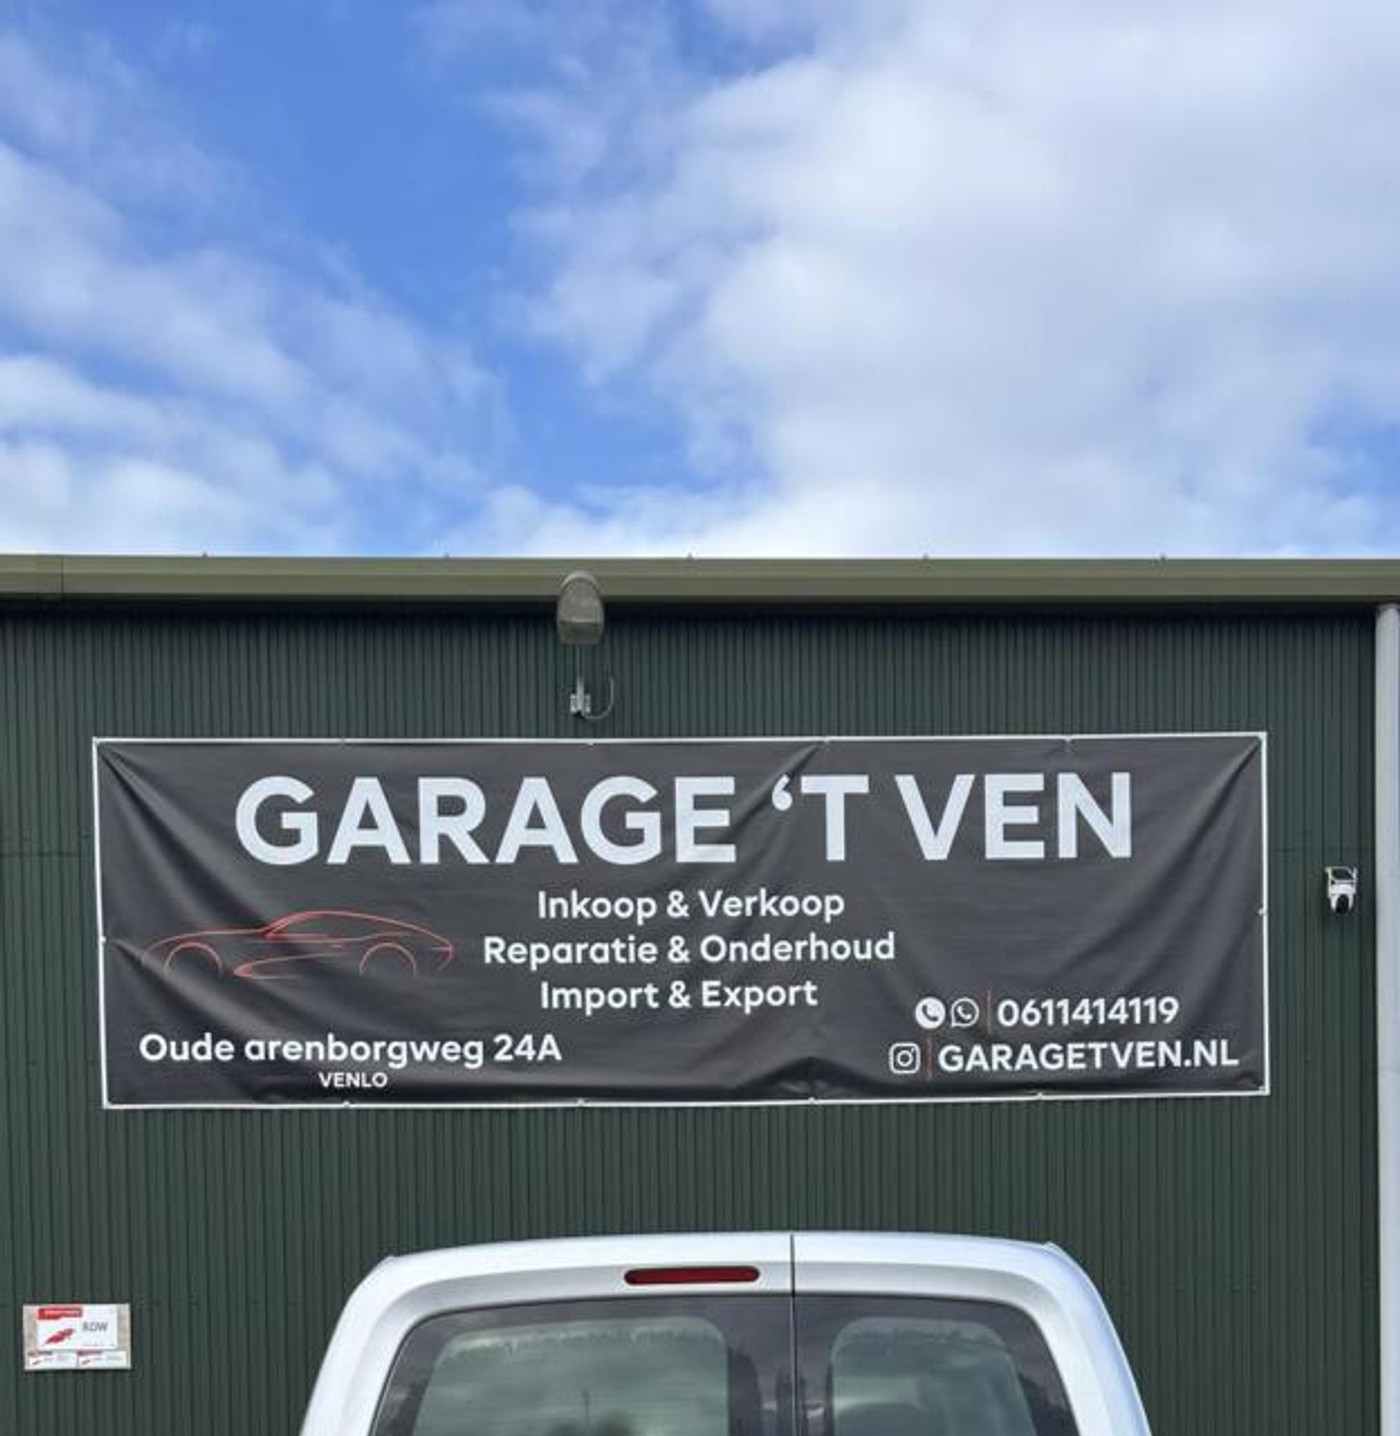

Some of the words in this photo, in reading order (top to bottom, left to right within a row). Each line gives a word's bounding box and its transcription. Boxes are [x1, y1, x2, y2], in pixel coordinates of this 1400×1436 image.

[235, 775, 737, 866] GARAGE
[771, 774, 870, 862] ‘T
[894, 771, 1132, 861] VEN
[538, 888, 658, 923] Inkoop
[666, 889, 690, 919] &
[697, 887, 845, 924] Verkoop
[484, 934, 659, 972] Reparatie
[667, 935, 691, 964] &
[699, 930, 895, 963] Onderhoud
[540, 981, 660, 1017] Import
[668, 980, 691, 1009] &
[701, 979, 819, 1016] Export
[997, 996, 1180, 1027] 0611414119
[139, 1032, 235, 1062] Oude
[244, 1032, 484, 1068] arenborgweg
[493, 1033, 563, 1062] 24A
[937, 1038, 1240, 1073] GARAGETVEN.NL
[318, 1071, 388, 1088] VENLO
[82, 1321, 108, 1332] RDW
